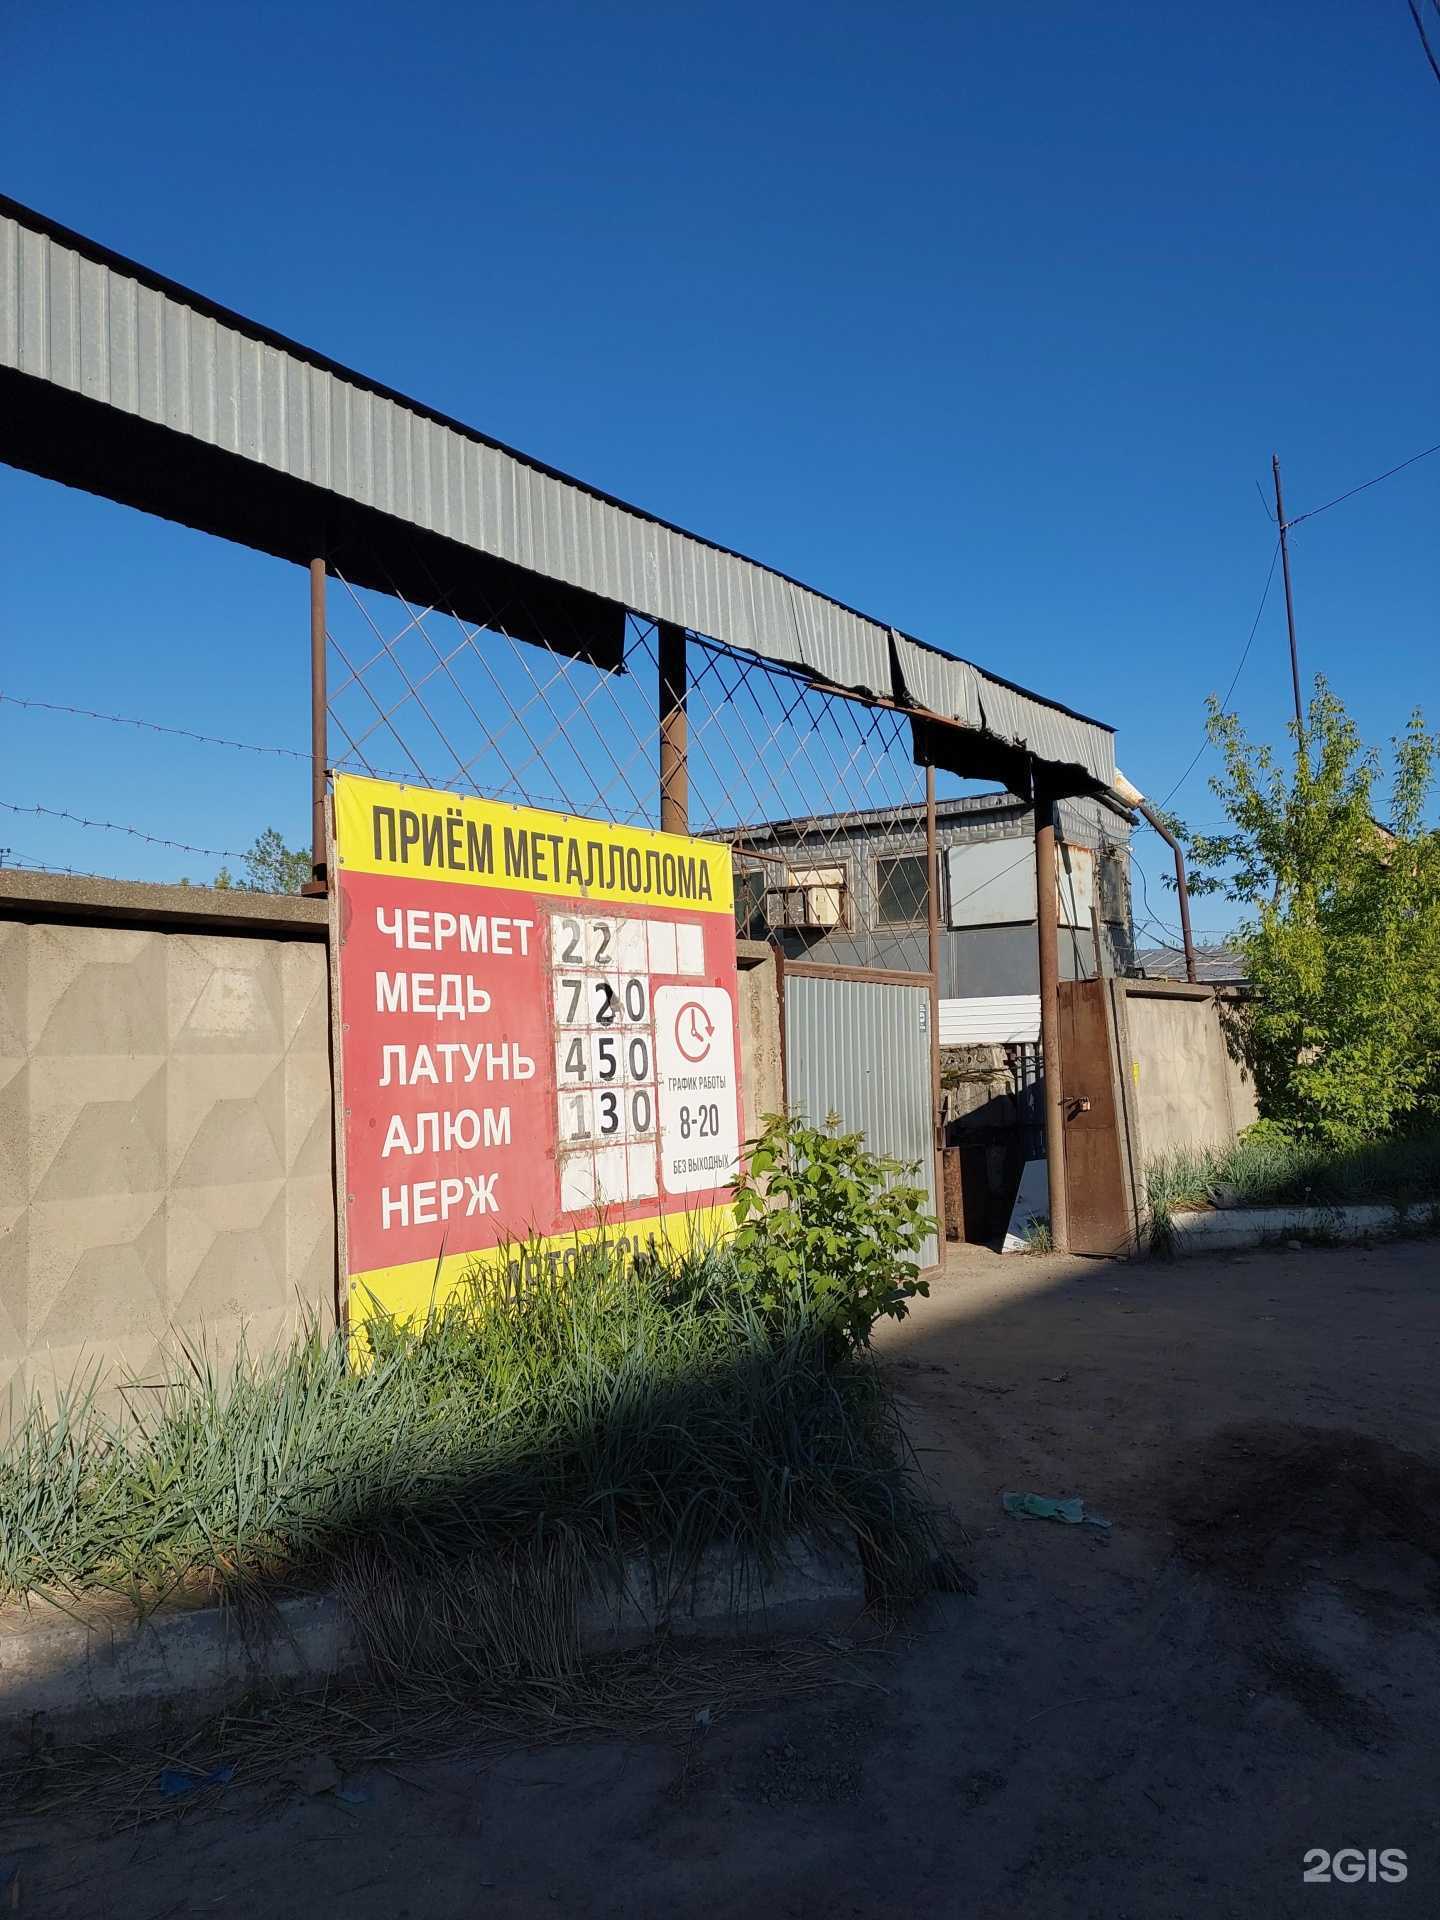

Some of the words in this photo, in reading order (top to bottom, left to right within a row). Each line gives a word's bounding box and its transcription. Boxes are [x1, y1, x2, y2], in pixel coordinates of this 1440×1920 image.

[372, 805, 494, 875] ПРИЁМ
[504, 827, 713, 902] МЕТАЛЛОЛОМА
[376, 907, 534, 956] ЧЕРМЕТ
[562, 919, 613, 964] 22
[376, 971, 492, 1021] МЕДЬ
[562, 978, 645, 1028] 720
[379, 1043, 536, 1087] ЛАТУНЬ
[565, 1037, 649, 1081] 450
[668, 1076, 697, 1092] ГРАФИК
[699, 1075, 727, 1090] РАБОТЫ
[381, 1106, 511, 1158] АЛЮМ
[569, 1089, 652, 1141] 130
[679, 1103, 720, 1140] 8-20
[673, 1159, 687, 1175] БЕЗ
[688, 1154, 729, 1174] ВЫХОДНЫХ
[382, 1172, 500, 1230] НЕРЖ
